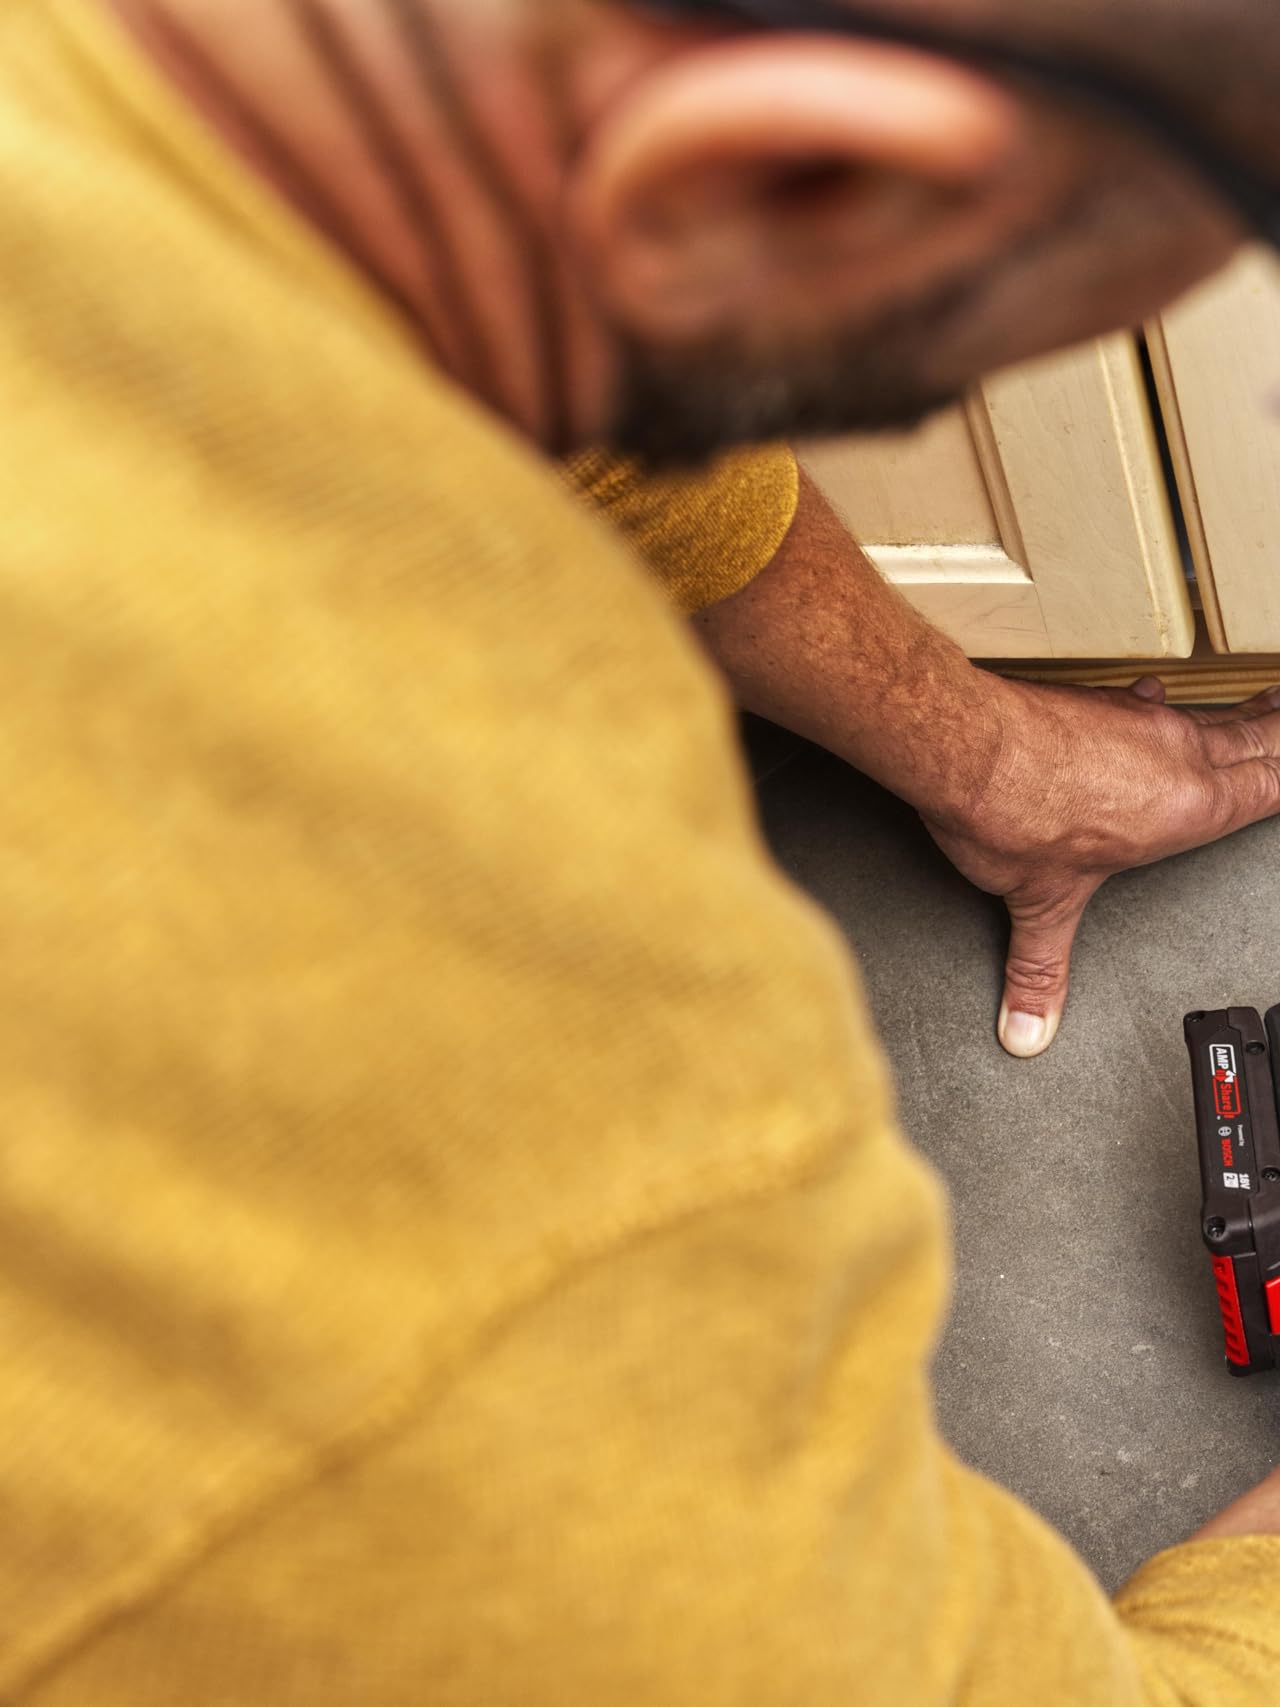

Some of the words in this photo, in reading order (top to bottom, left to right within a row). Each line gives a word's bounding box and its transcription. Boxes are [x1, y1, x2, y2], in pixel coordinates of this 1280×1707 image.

[1216, 1047, 1229, 1070] AMP
[1220, 1083, 1233, 1111] Share
[1221, 1138, 1233, 1167] BOSCH
[1239, 1173, 1250, 1190] 18V
